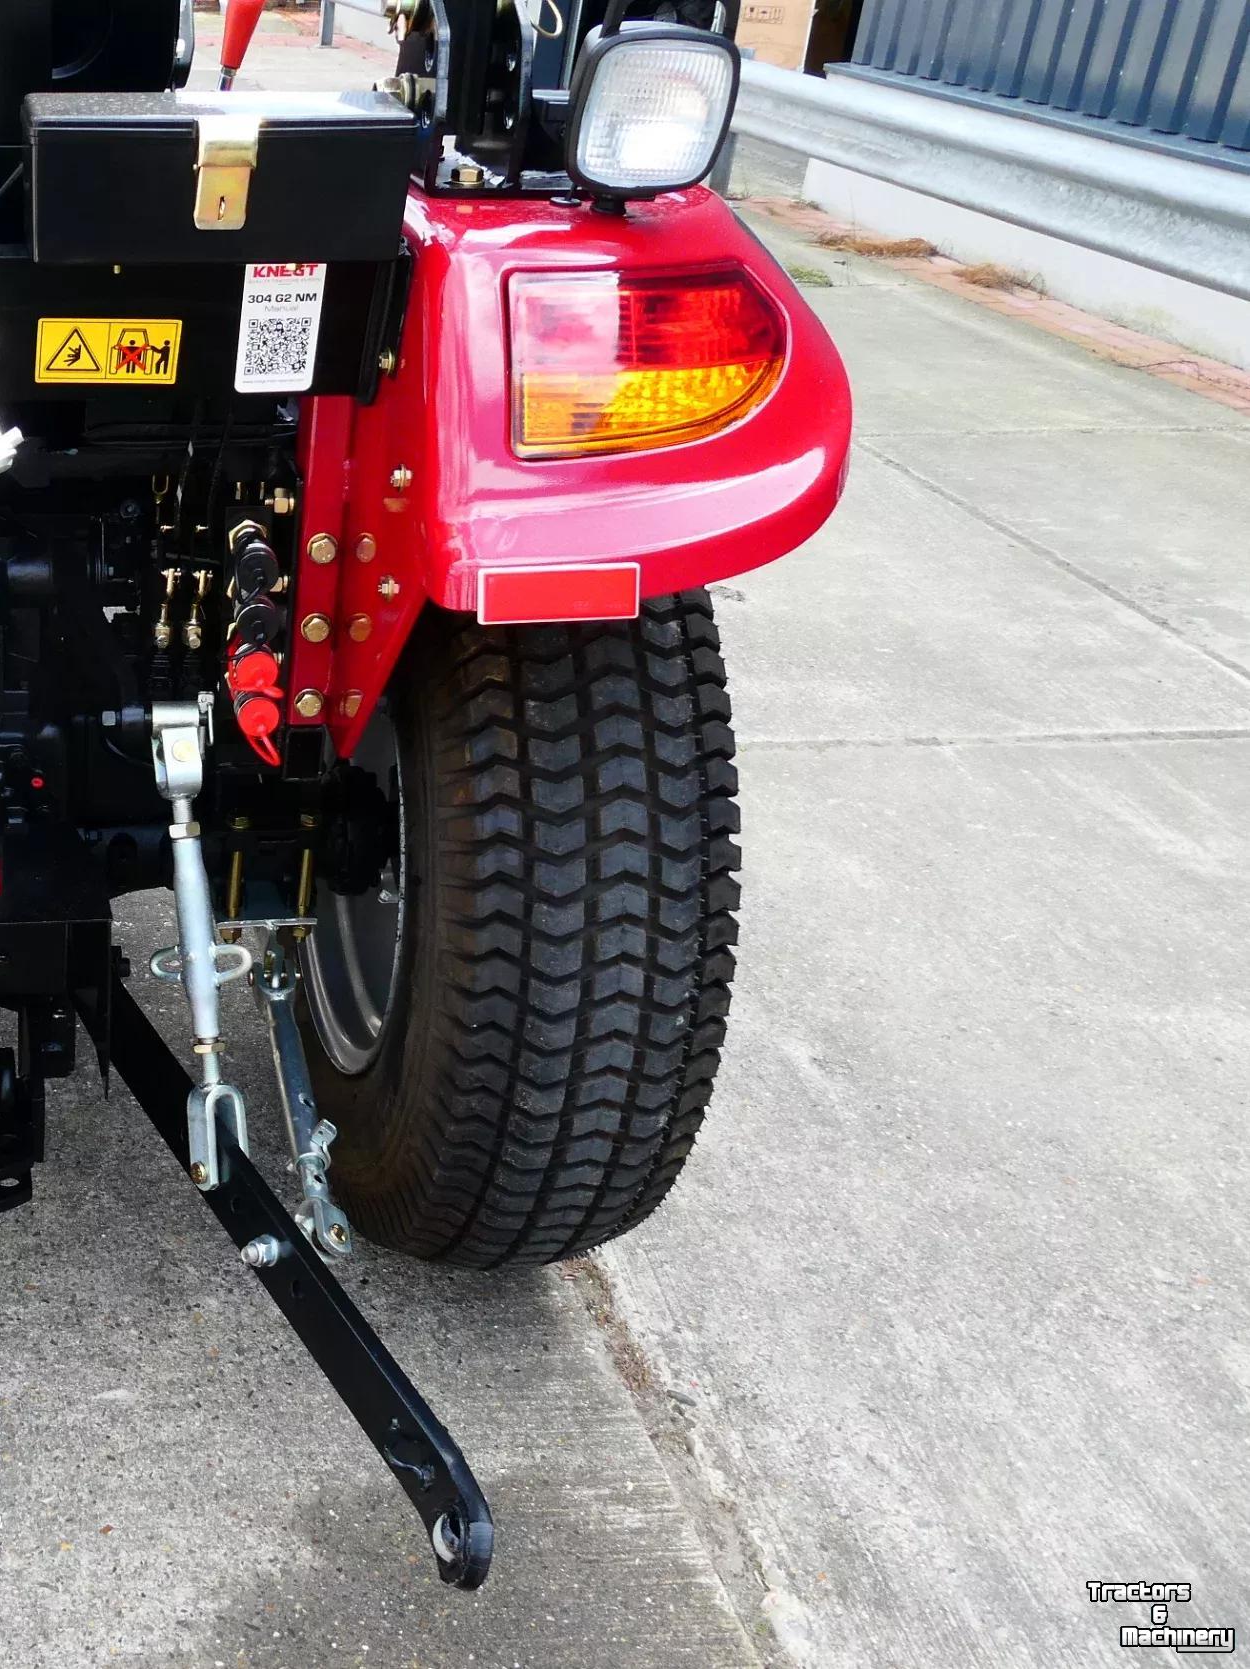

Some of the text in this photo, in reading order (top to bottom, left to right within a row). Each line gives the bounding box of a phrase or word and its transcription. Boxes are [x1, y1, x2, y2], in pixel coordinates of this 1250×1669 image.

[253, 264, 318, 278] KNEGT
[247, 292, 317, 304] 304 G2 NM
[264, 304, 299, 312] Manual
